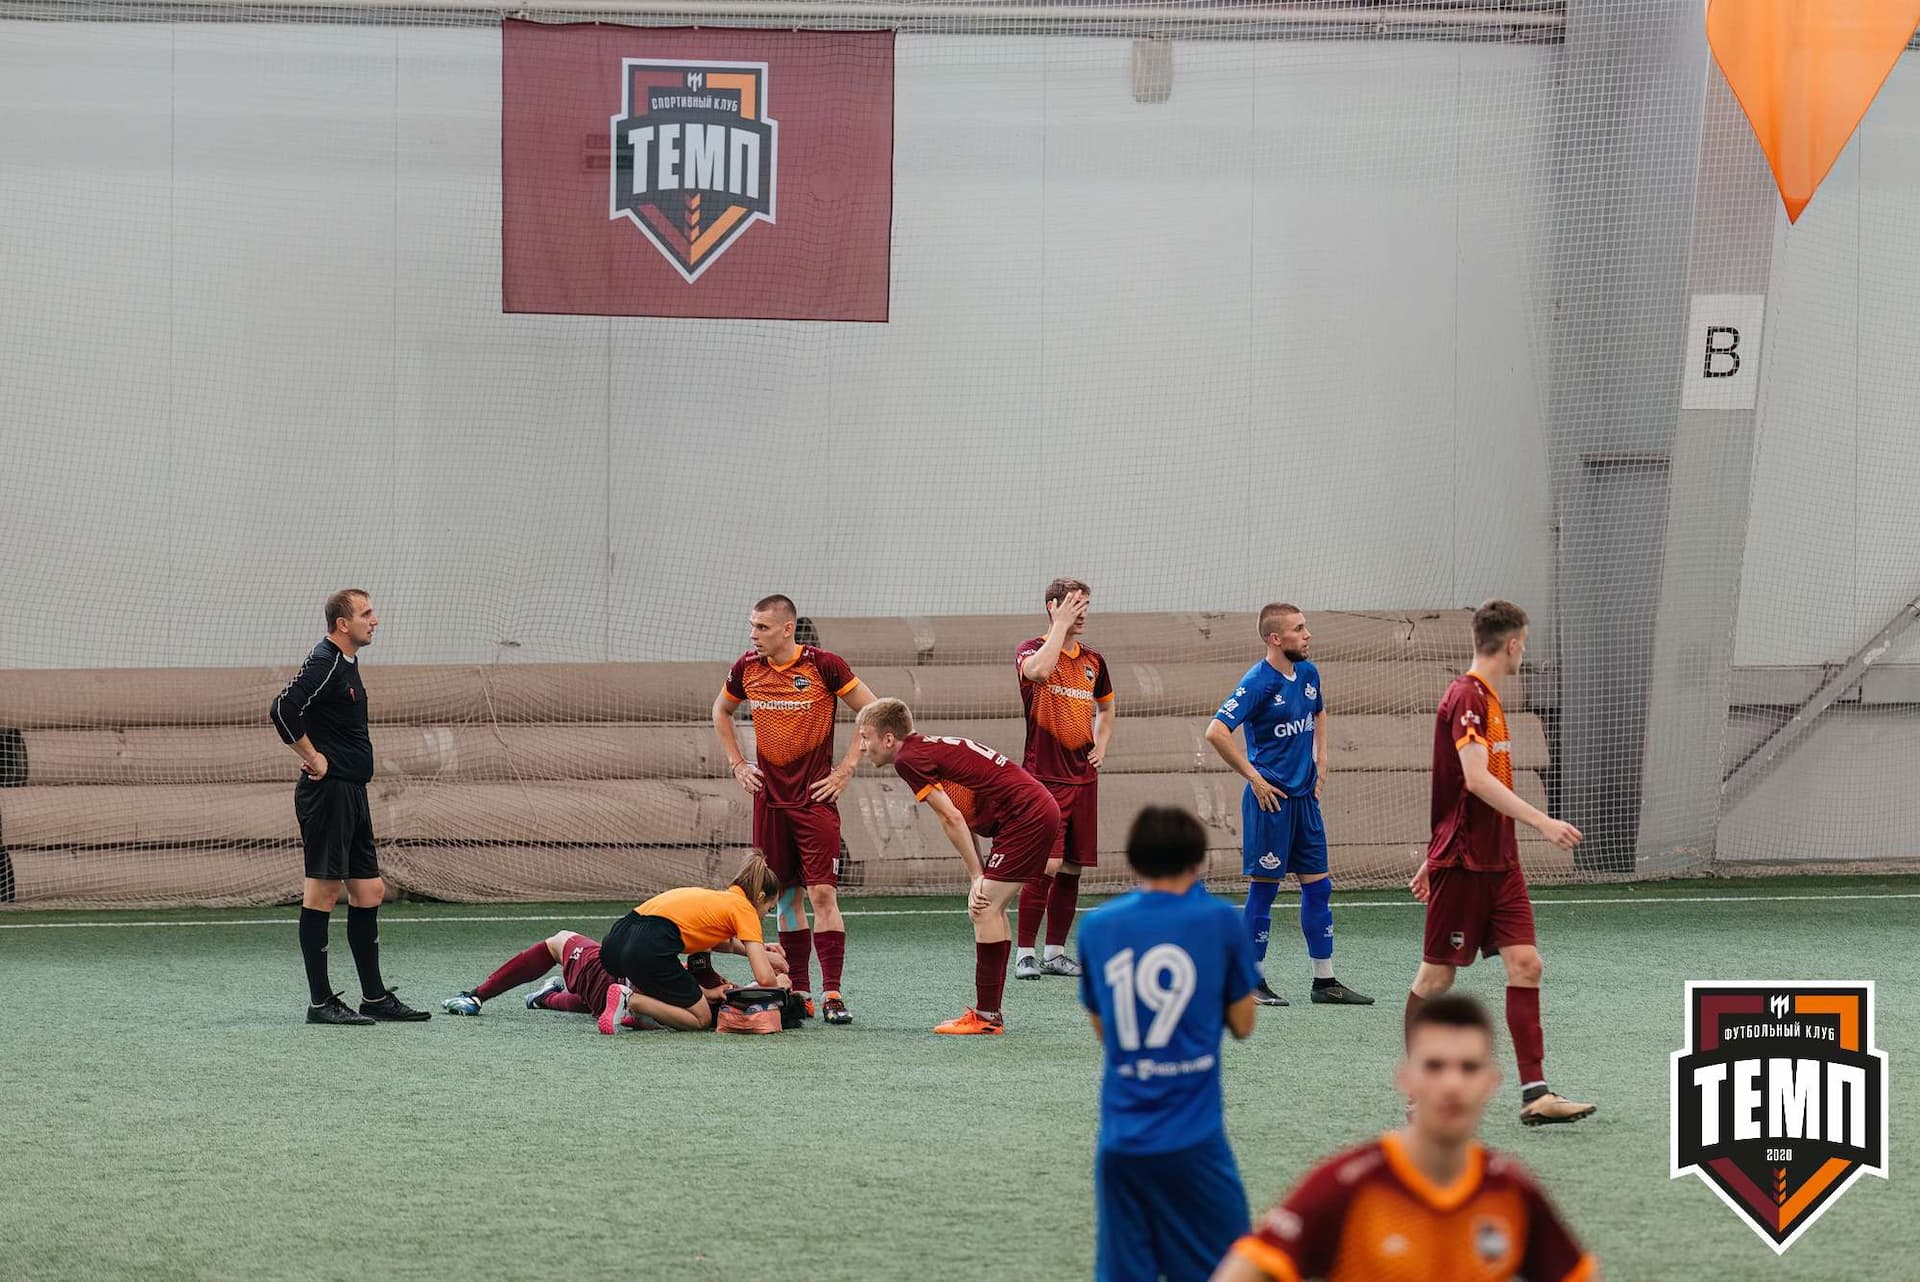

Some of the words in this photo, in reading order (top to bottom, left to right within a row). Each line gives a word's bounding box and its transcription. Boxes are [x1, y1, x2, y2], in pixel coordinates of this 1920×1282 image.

[651, 95, 712, 110] СПОРТИВНЫЙ
[713, 98, 738, 112] КЛУБ
[627, 122, 761, 200] ТЕМП
[1103, 942, 1198, 1052] 19
